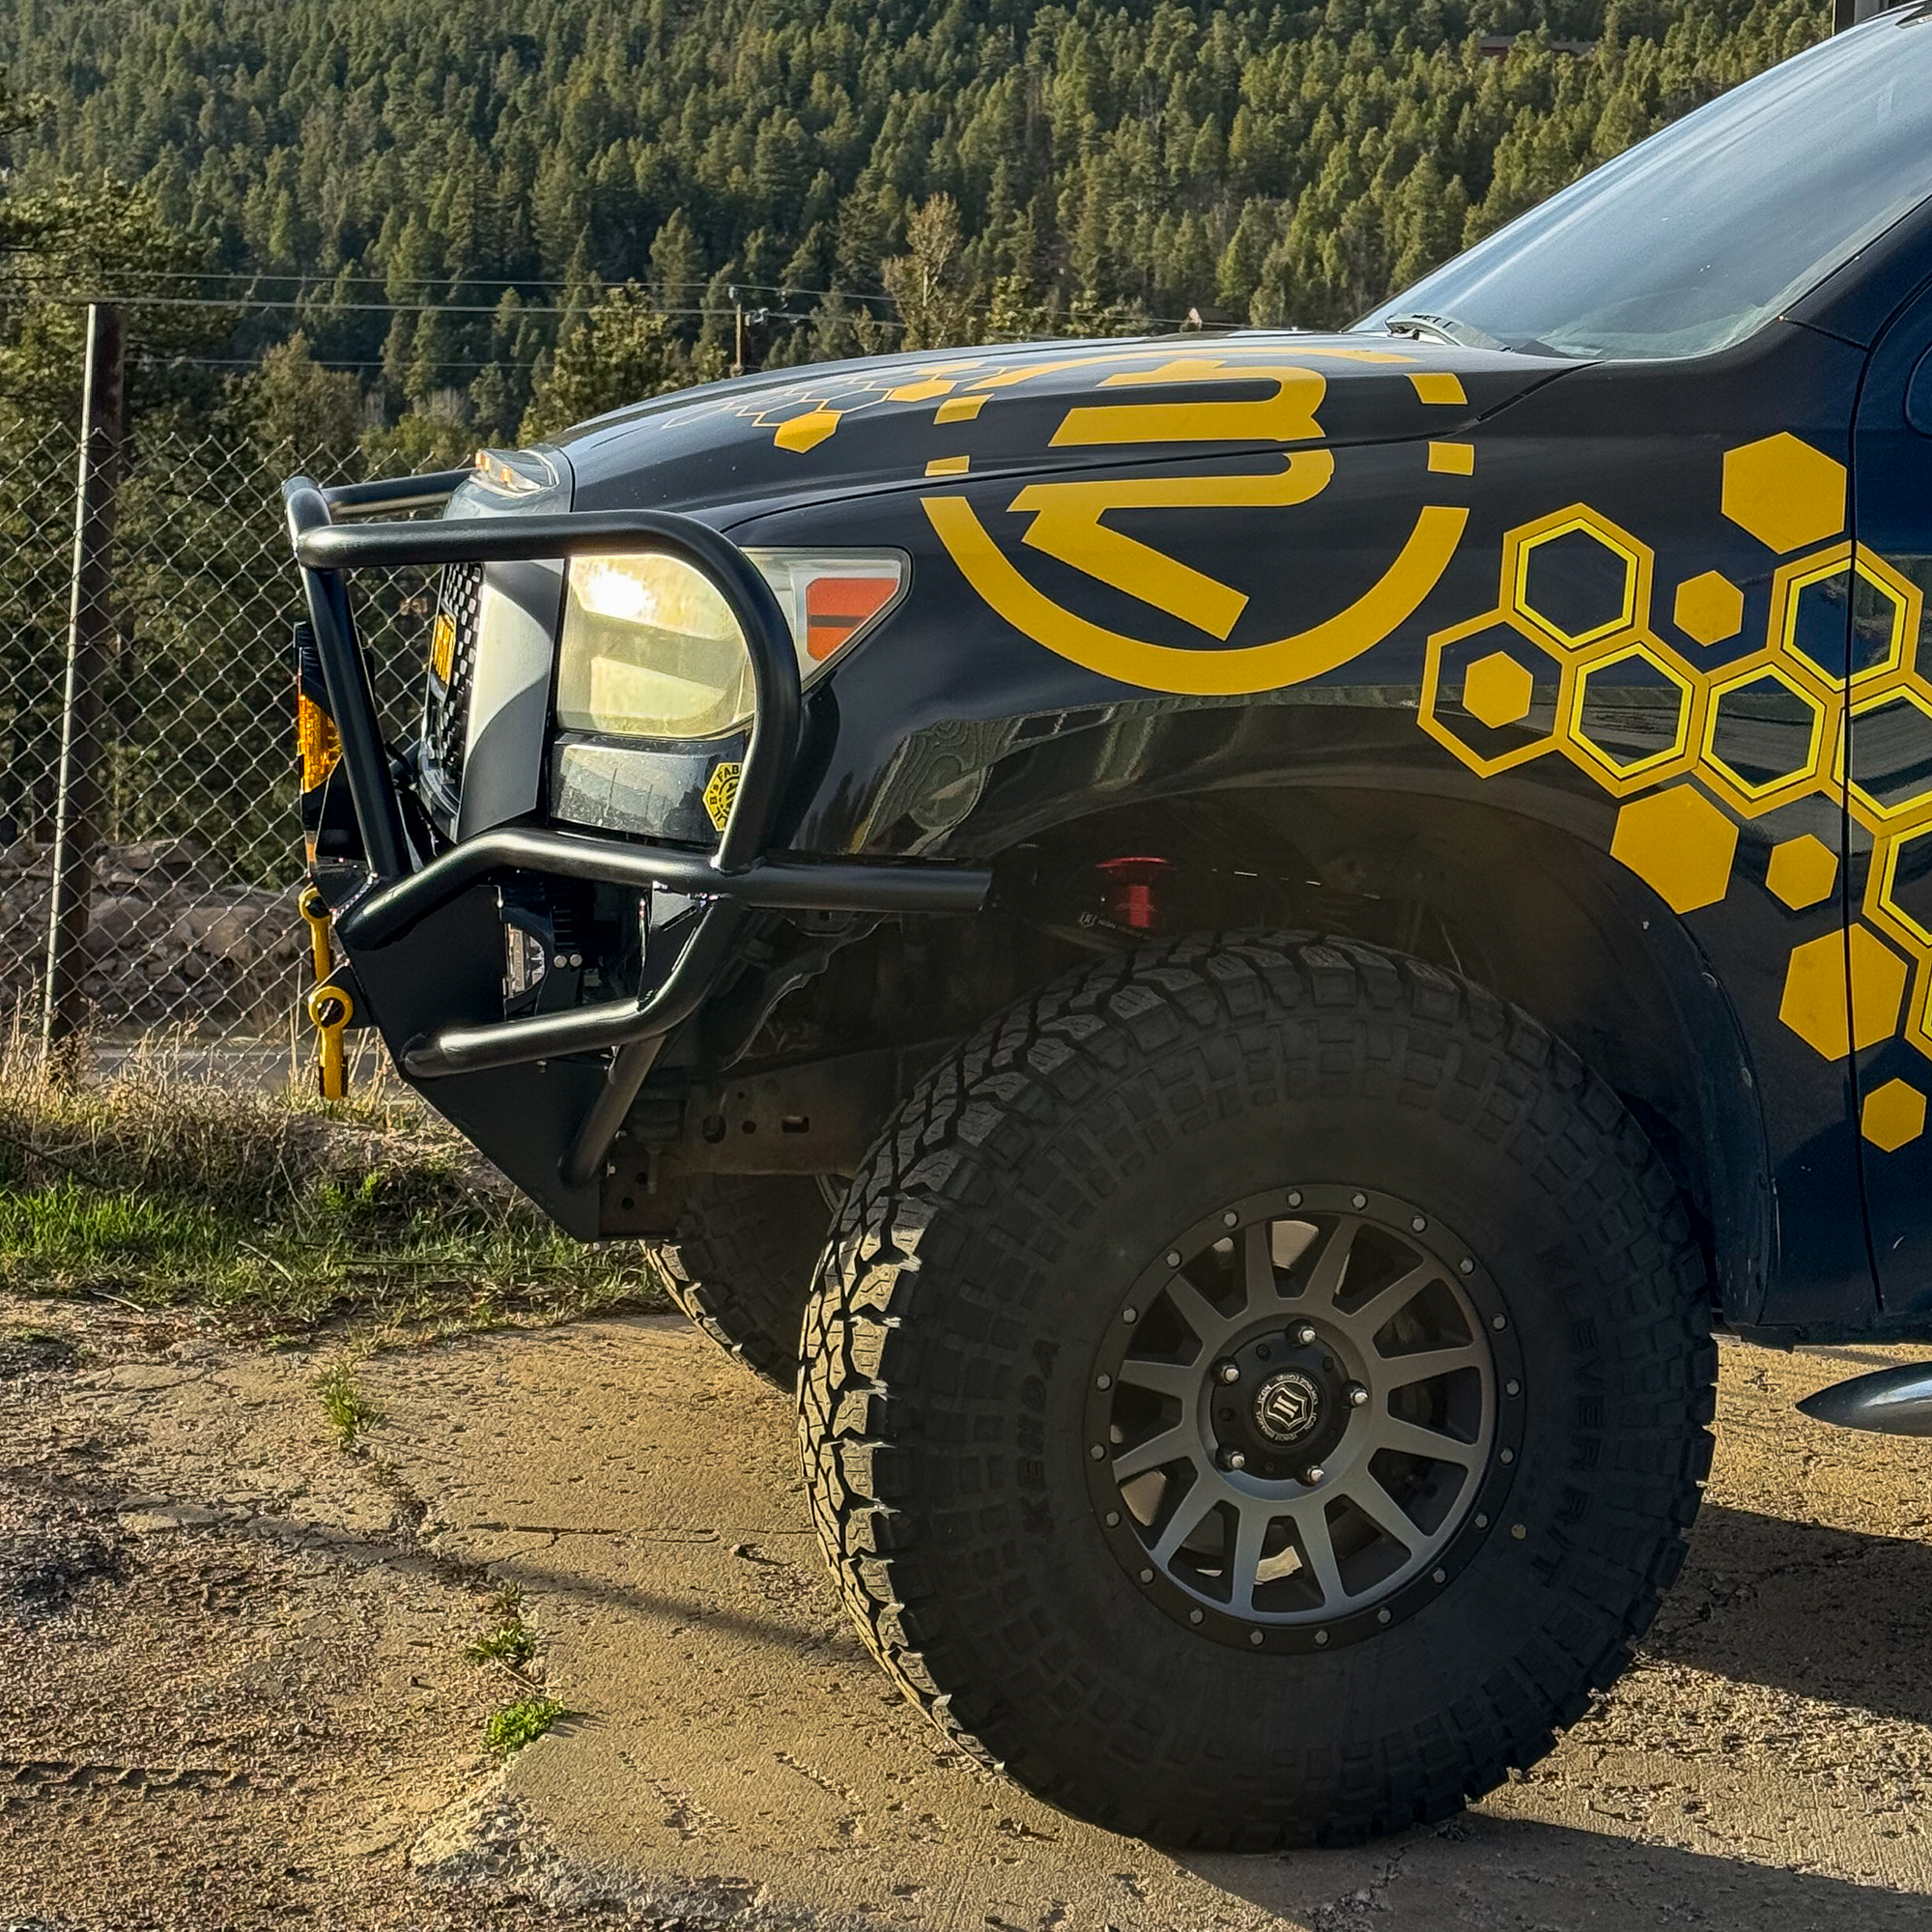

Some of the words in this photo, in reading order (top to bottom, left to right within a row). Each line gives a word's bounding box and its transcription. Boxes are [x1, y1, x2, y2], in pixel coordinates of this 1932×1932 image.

[717, 765, 739, 782] FAB
[1017, 1339, 1061, 1534] KENDA
[1537, 1244, 1605, 1470] KLEVER
